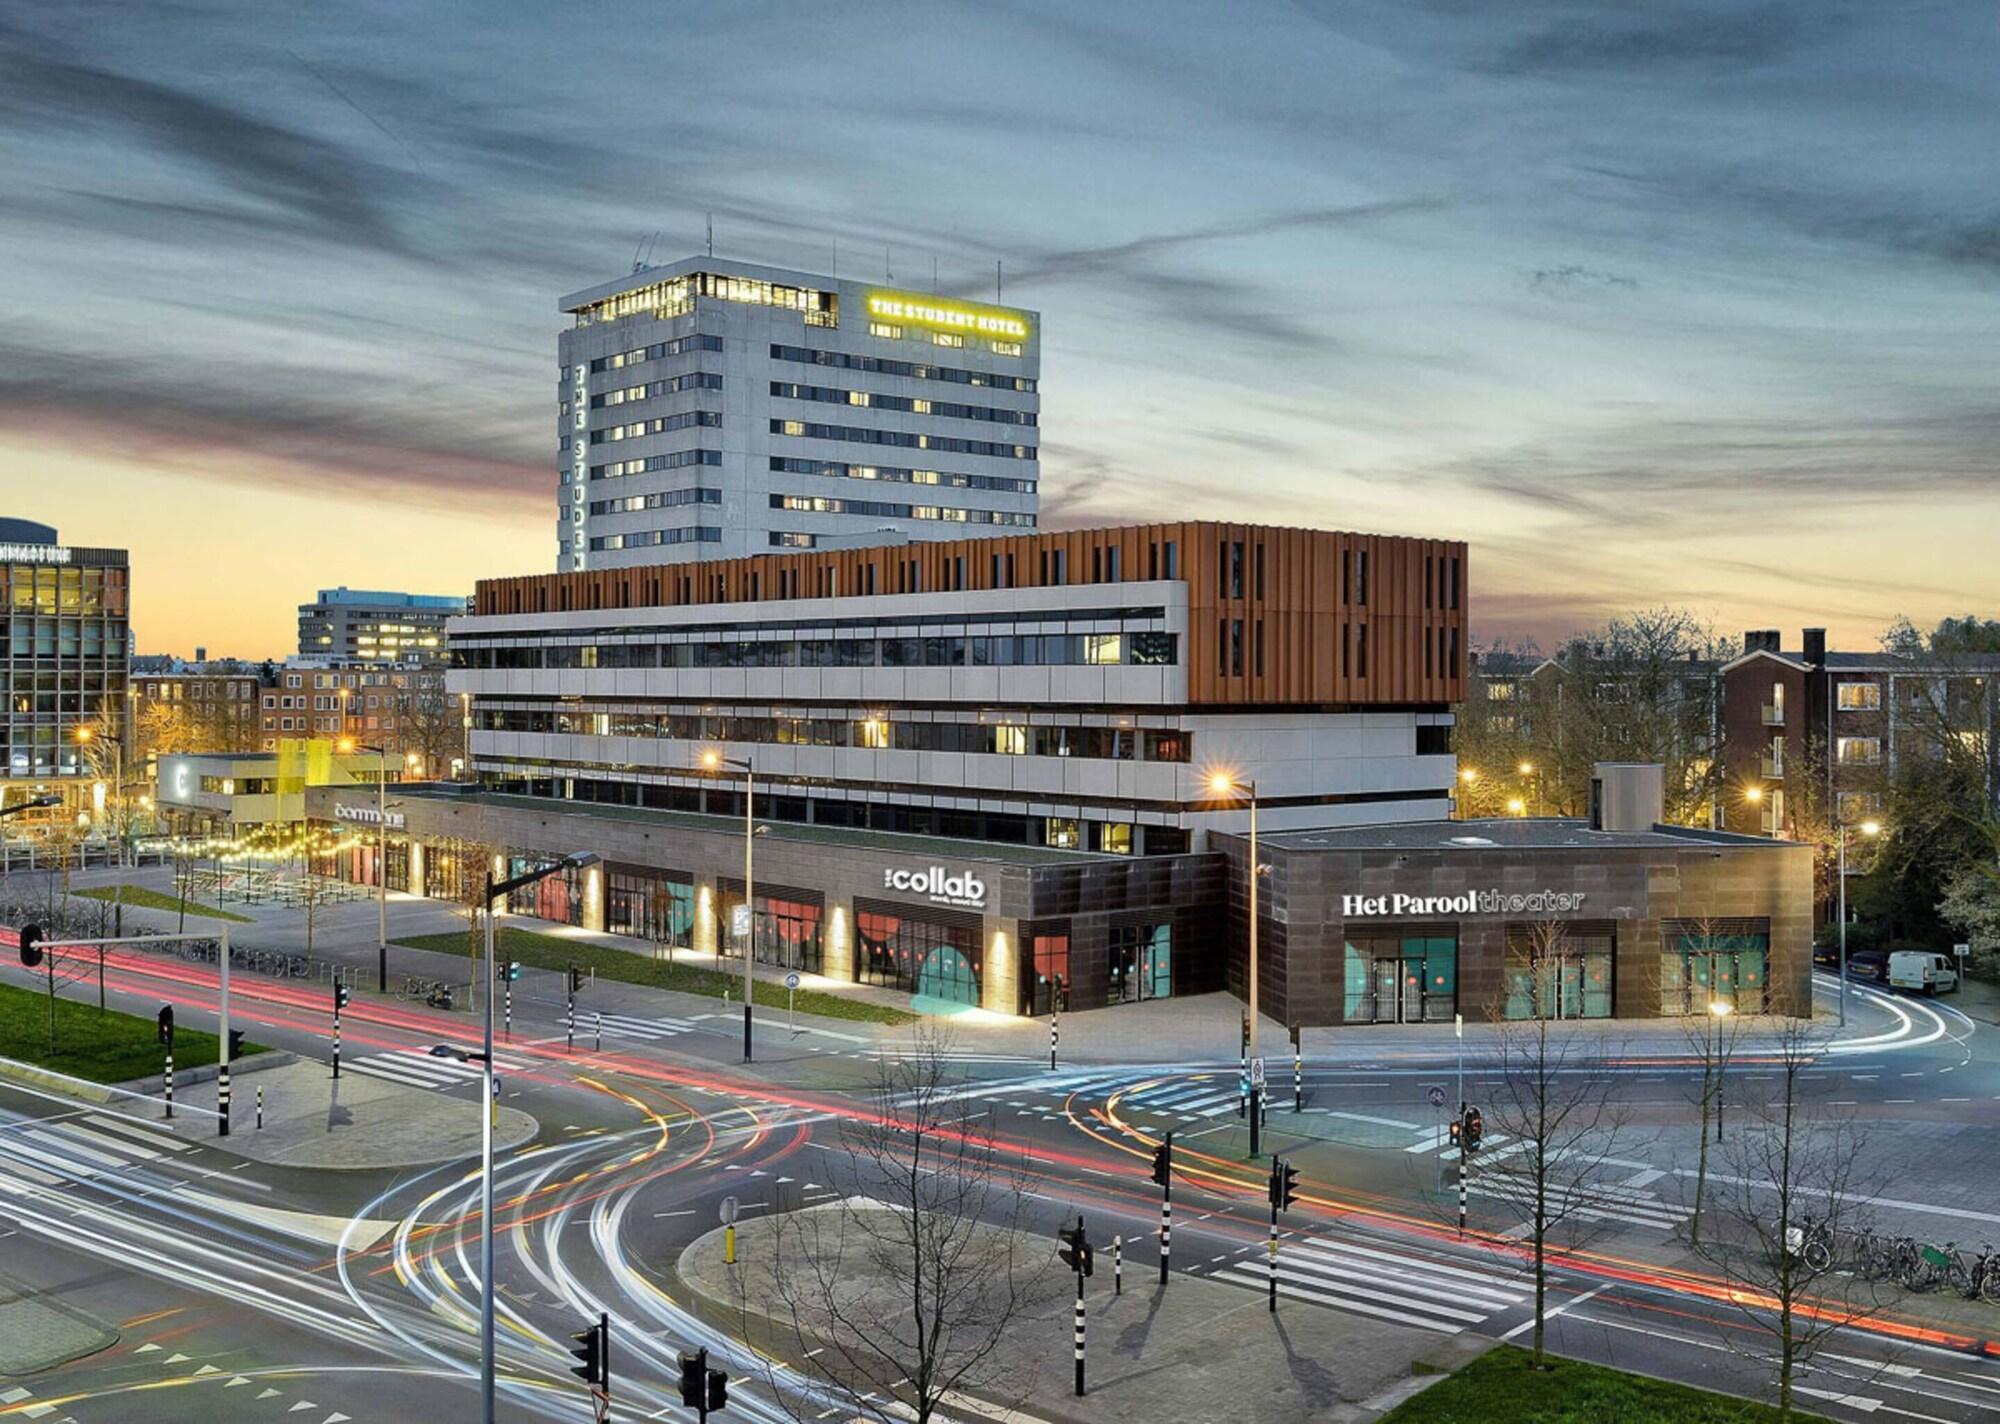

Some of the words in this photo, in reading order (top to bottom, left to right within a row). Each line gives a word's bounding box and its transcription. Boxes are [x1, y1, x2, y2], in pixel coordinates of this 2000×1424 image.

[871, 298, 902, 317] THE
[905, 305, 976, 328] STUDENT
[978, 315, 1025, 336] HOTEL
[574, 364, 586, 430] THE
[892, 866, 985, 899] collab
[1342, 895, 1388, 916] Het
